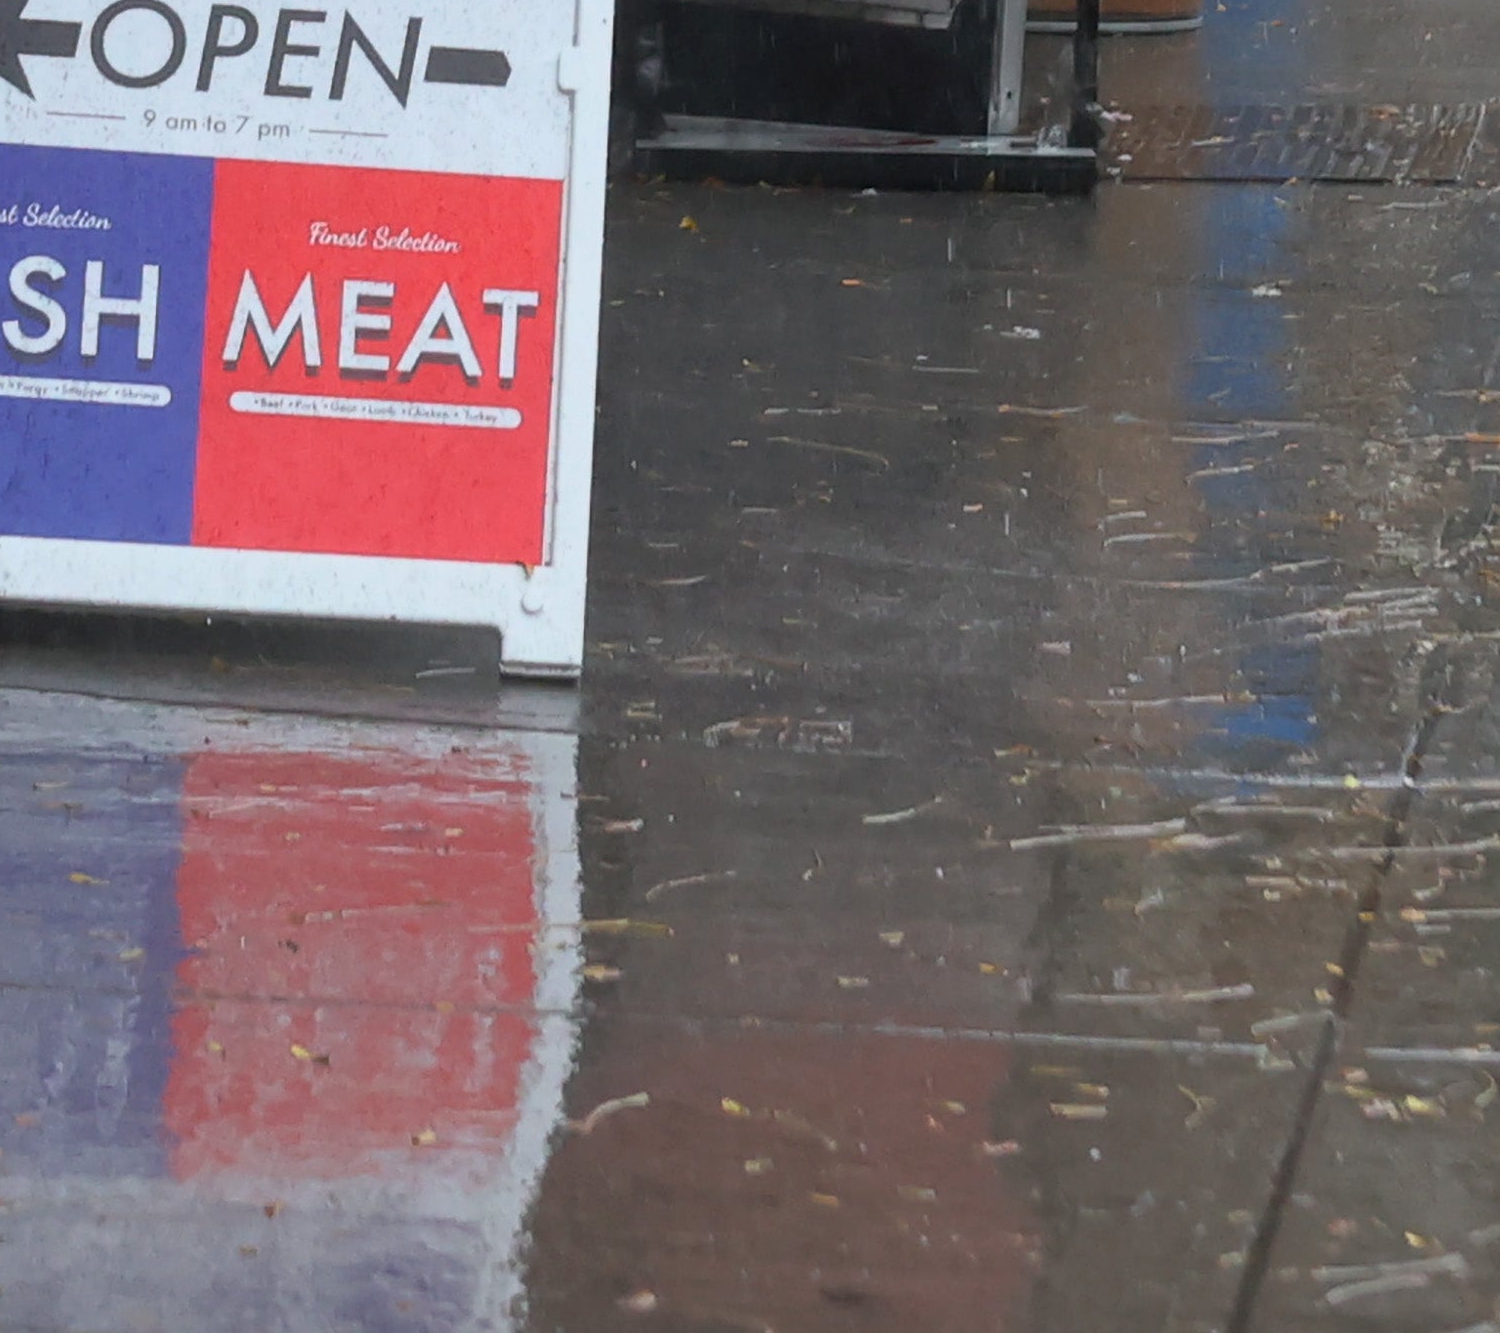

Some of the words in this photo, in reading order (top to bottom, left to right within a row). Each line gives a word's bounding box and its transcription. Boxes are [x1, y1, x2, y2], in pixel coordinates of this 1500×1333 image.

[142, 108, 157, 129] 9
[165, 116, 198, 132] am
[205, 115, 227, 134] to
[235, 114, 250, 135] 7
[257, 122, 291, 142] pm
[21, 202, 113, 232] Selection
[308, 220, 369, 249] Finest
[371, 224, 461, 255] Selection
[221, 269, 540, 385] MEAT
